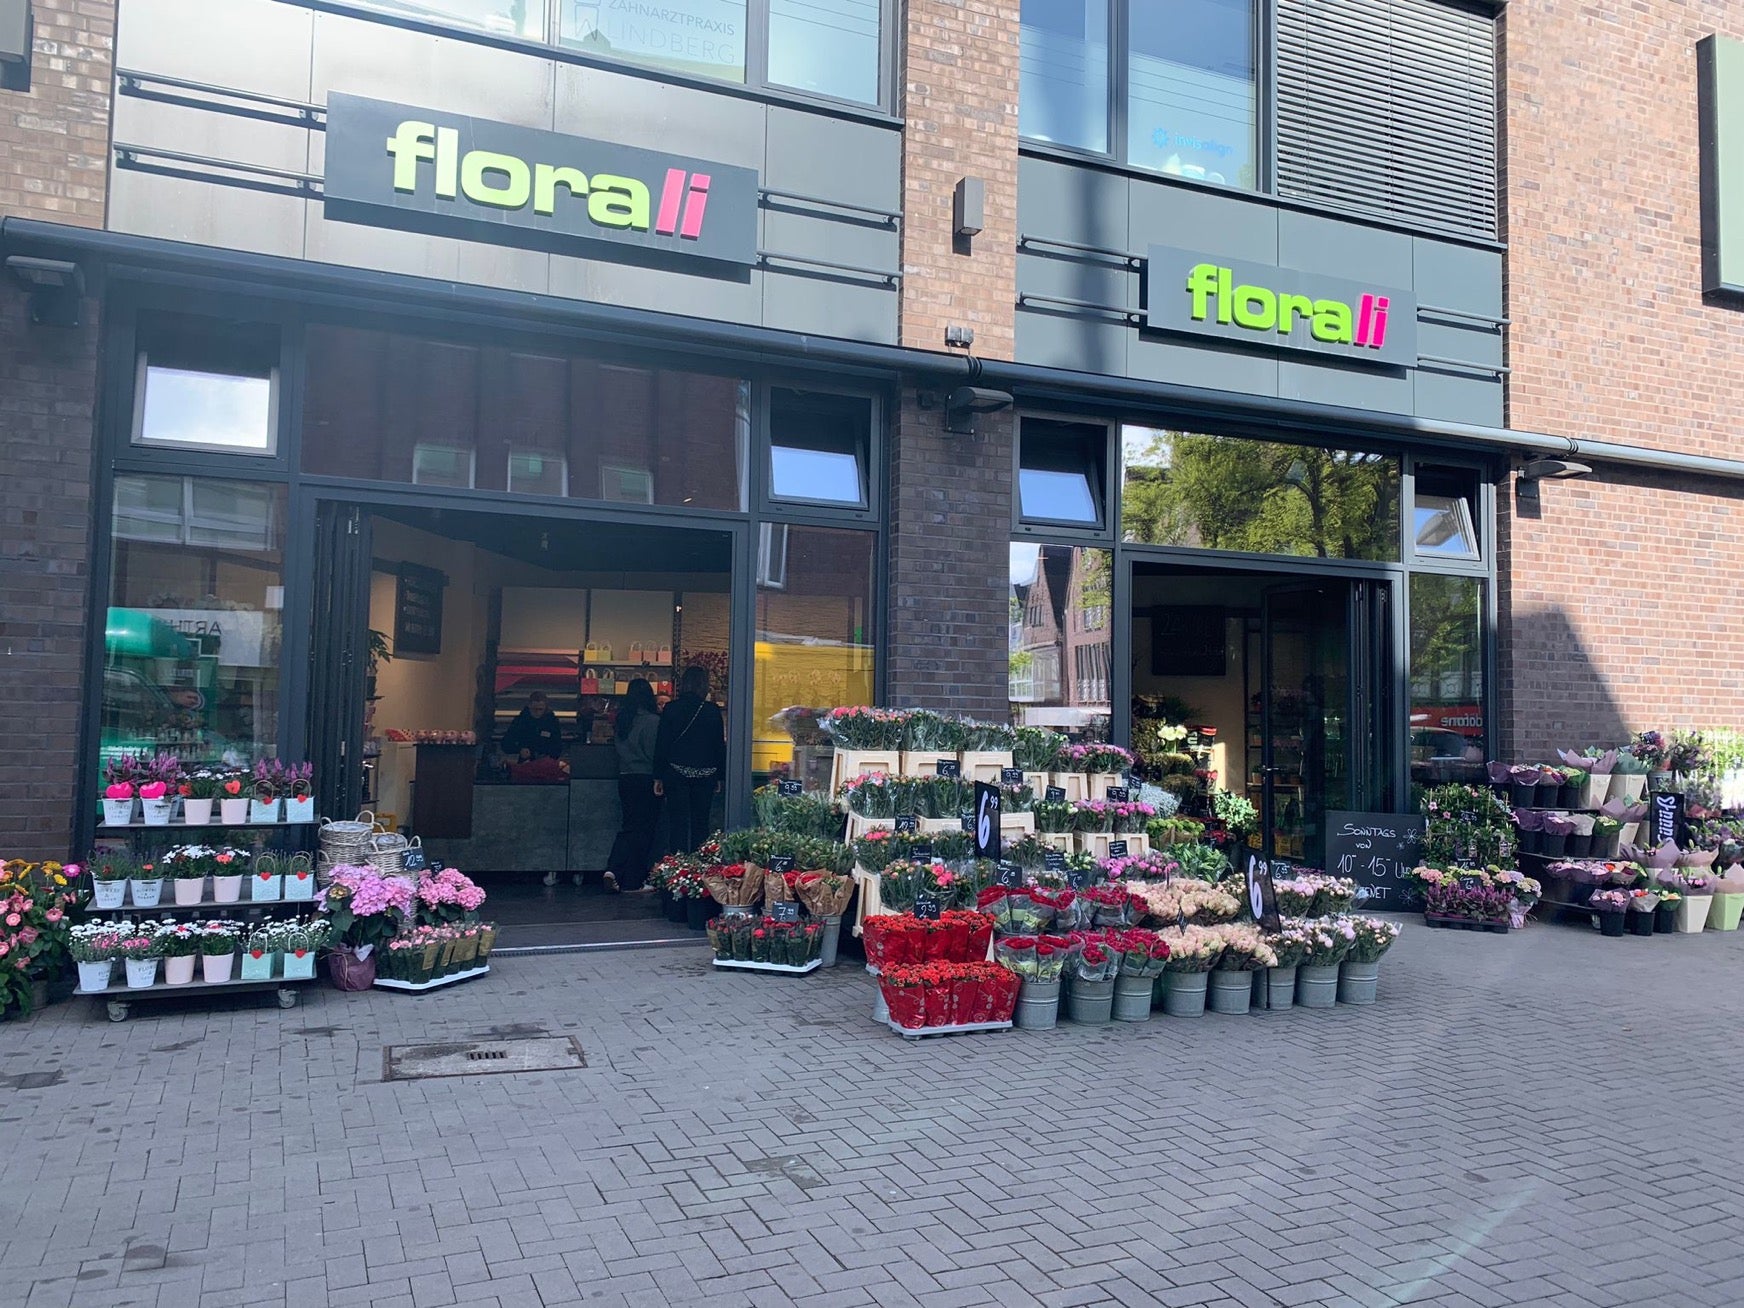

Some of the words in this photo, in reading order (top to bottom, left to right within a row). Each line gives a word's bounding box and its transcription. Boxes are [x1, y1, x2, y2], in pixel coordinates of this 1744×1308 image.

[608, 0, 735, 36] ZAHNARZTPRAXIS
[608, 19, 734, 64] LINDBERG
[387, 121, 711, 241] florali
[1187, 264, 1390, 349] florali
